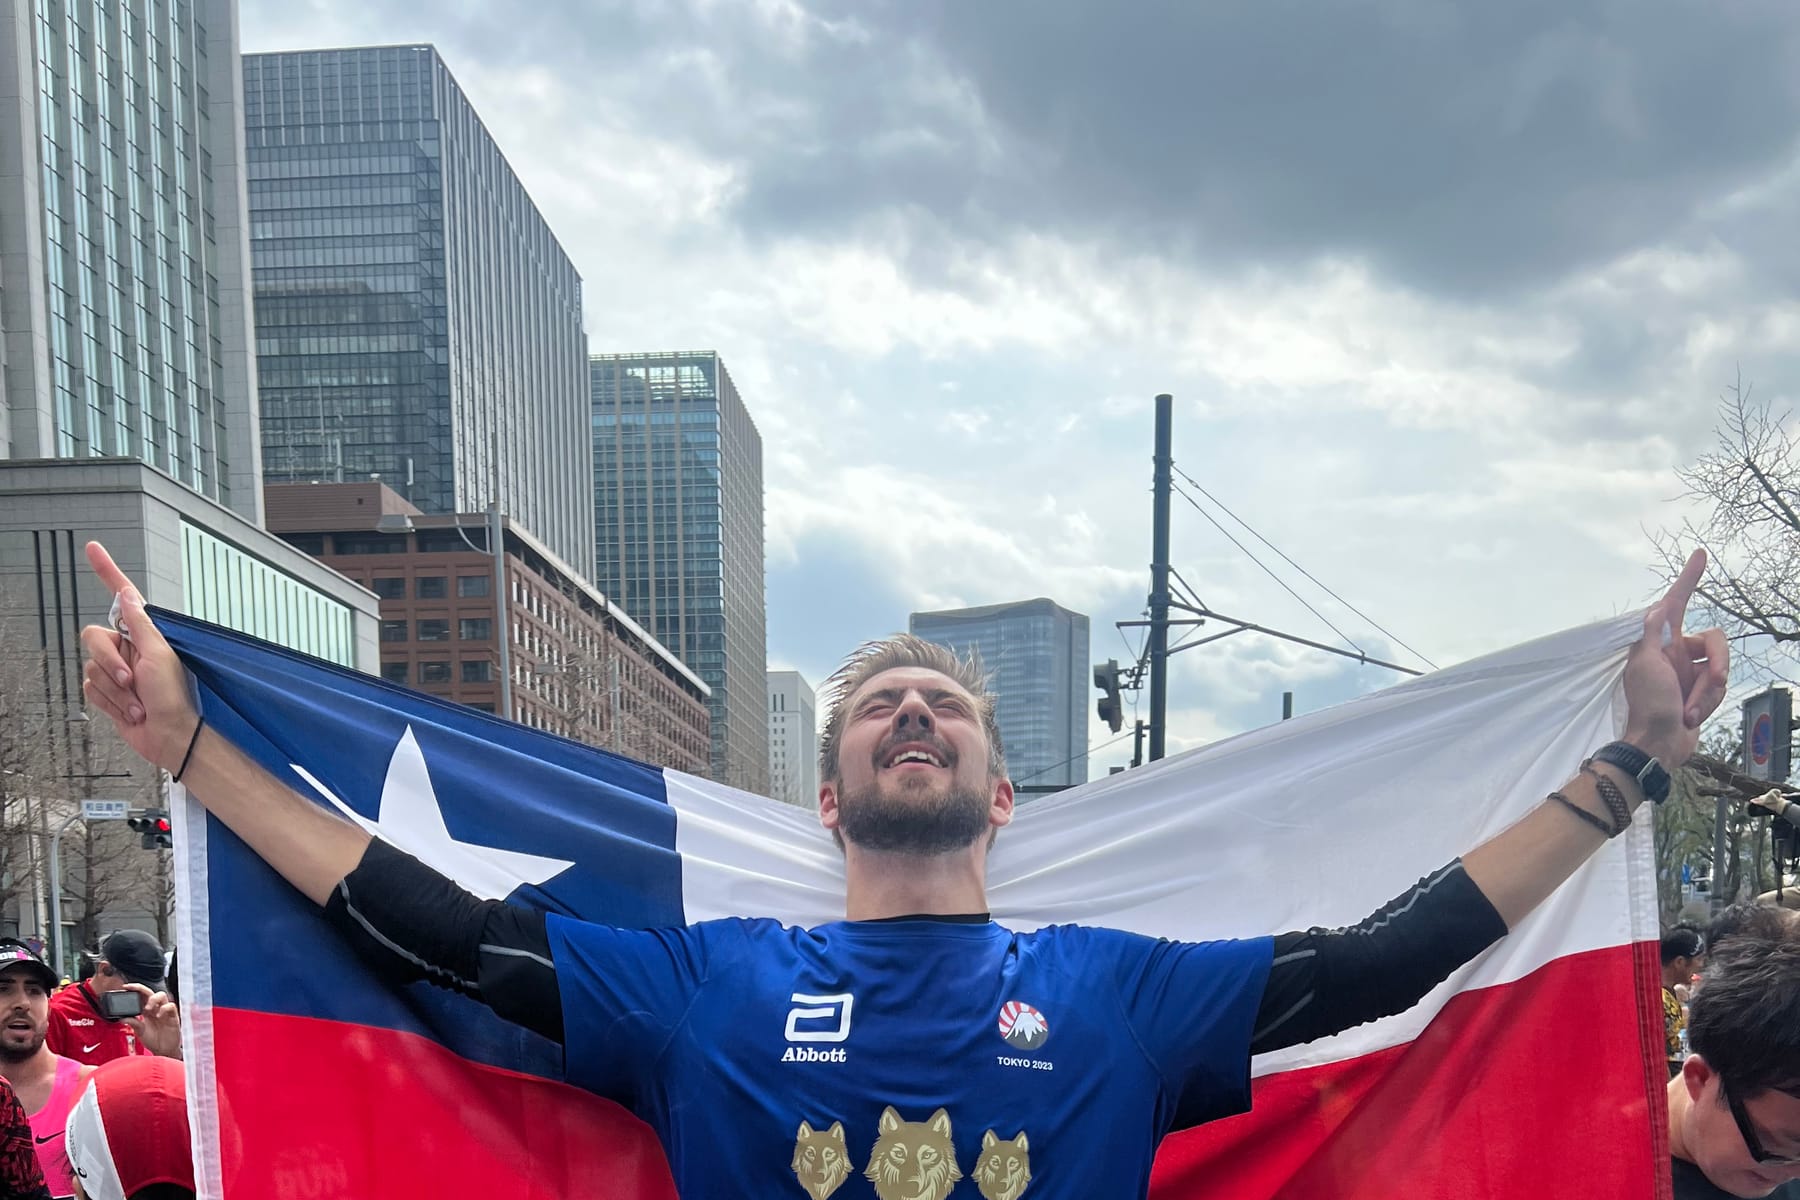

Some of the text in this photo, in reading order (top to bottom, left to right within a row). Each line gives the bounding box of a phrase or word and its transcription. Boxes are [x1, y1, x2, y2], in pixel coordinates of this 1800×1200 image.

[781, 1047, 847, 1063] Abbott
[997, 1056, 1053, 1071] TOKYO 2023
